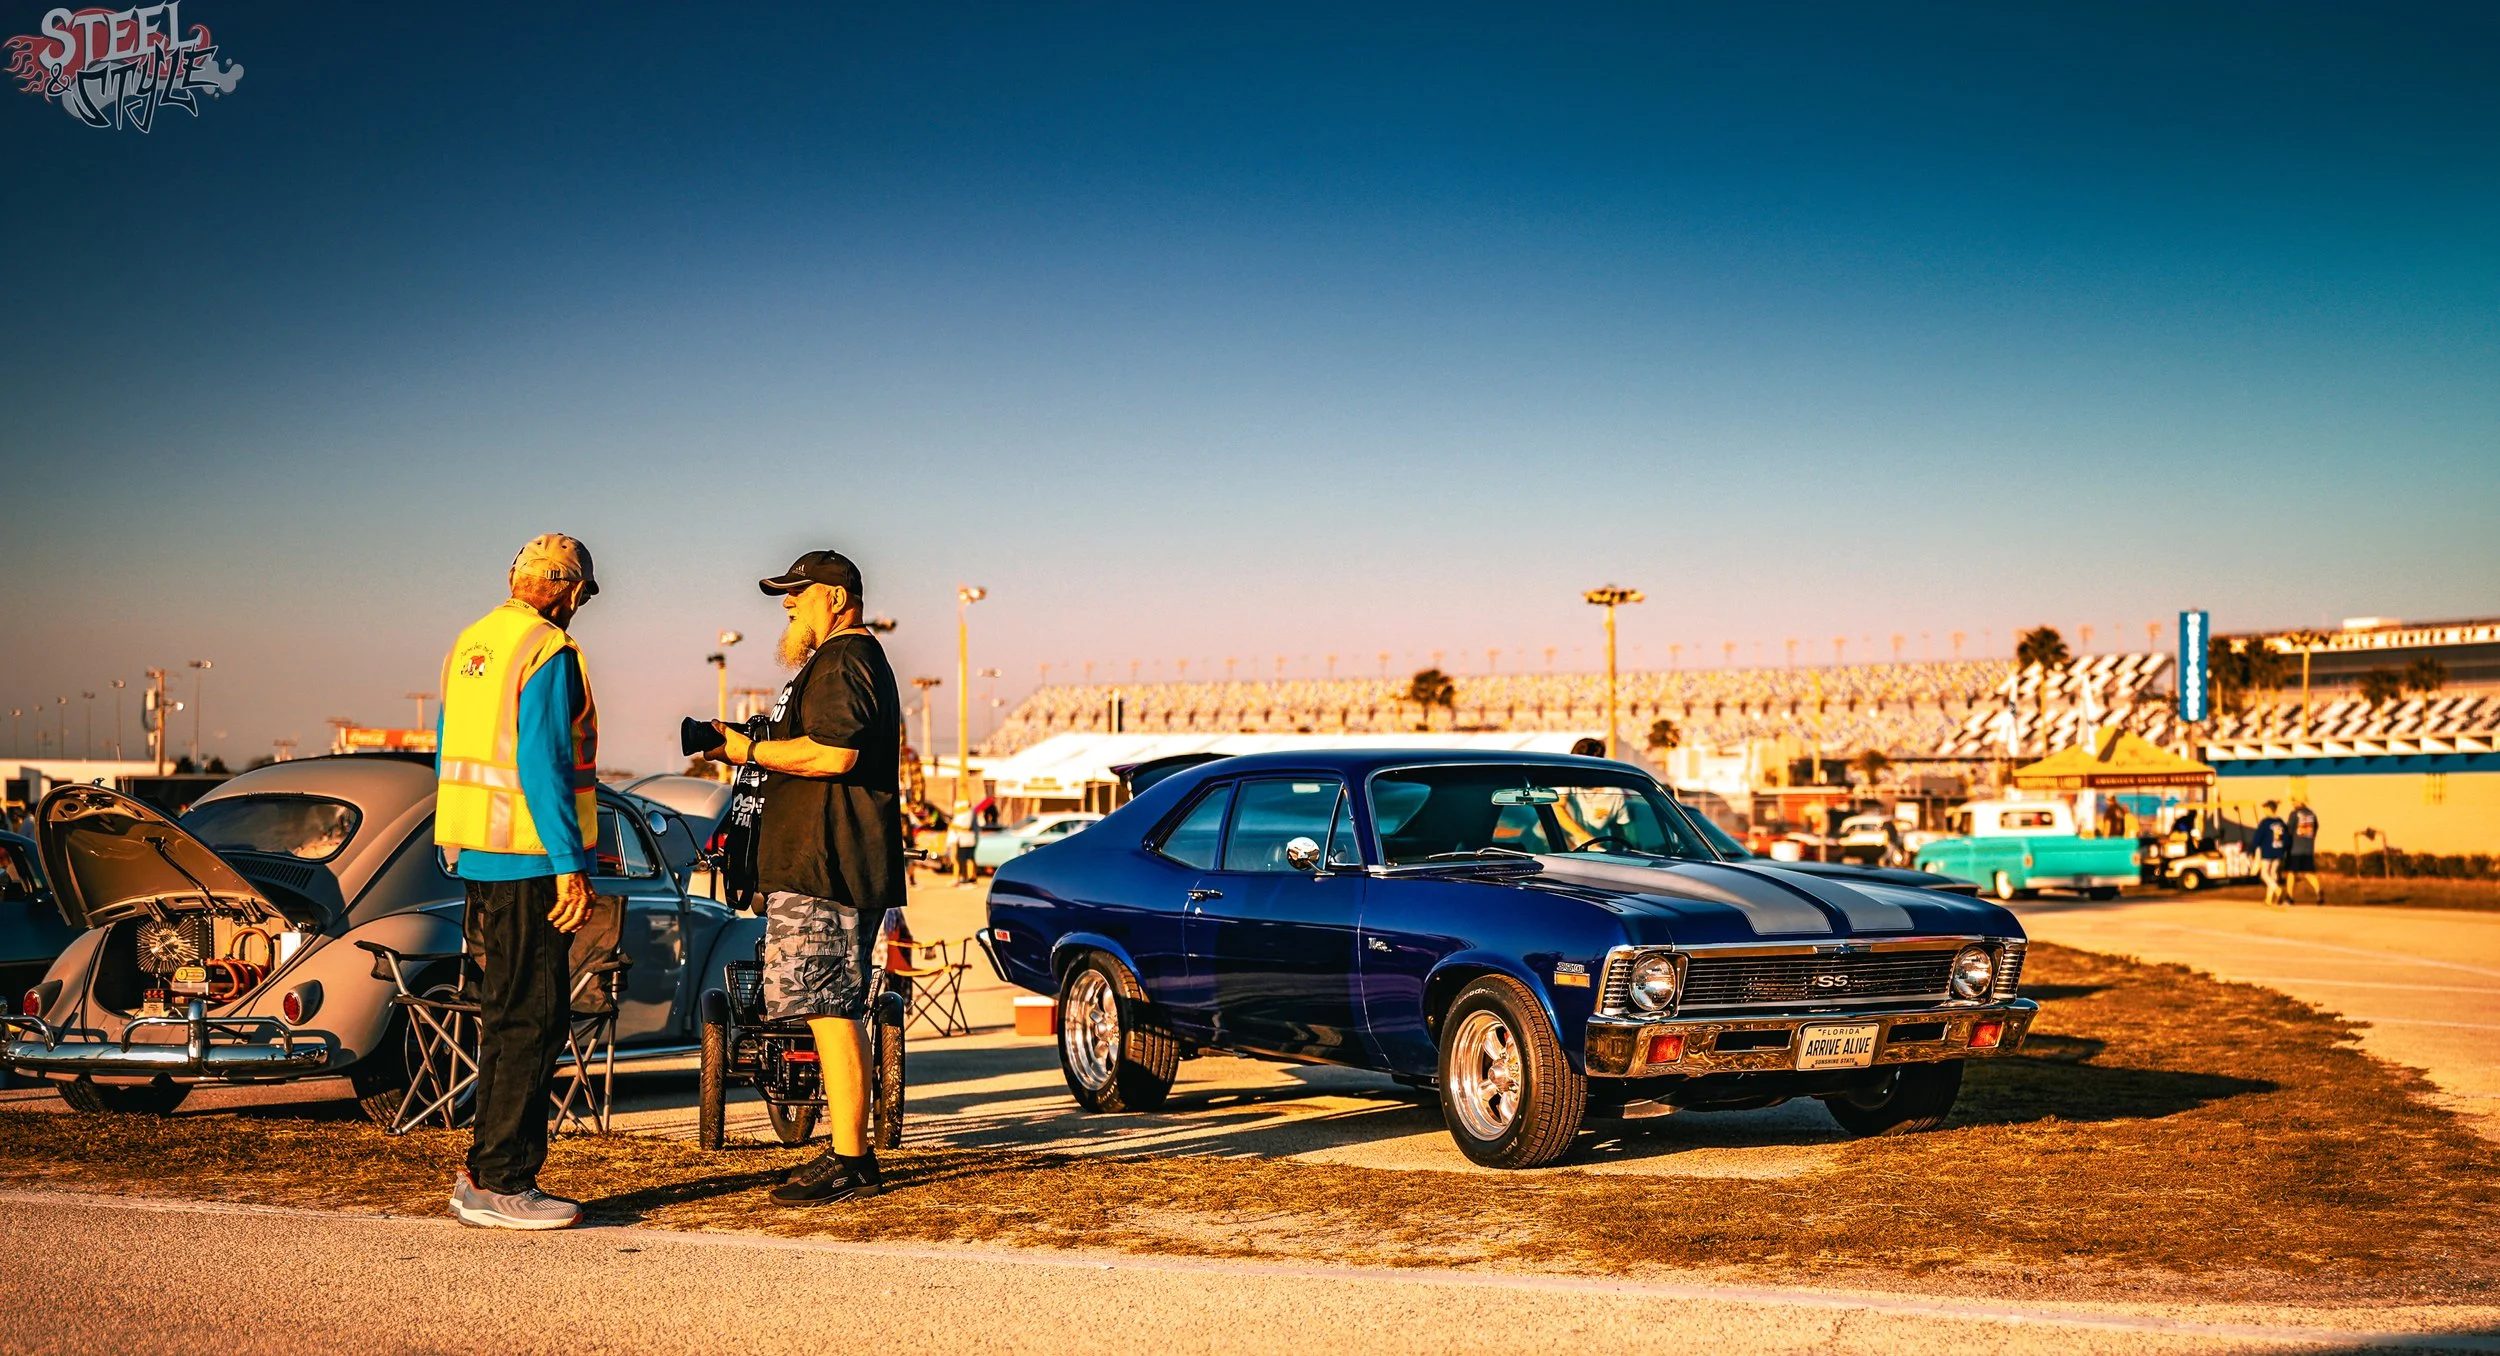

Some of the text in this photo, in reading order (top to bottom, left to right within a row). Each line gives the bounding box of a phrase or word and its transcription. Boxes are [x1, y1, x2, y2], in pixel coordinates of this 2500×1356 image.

[1822, 1028, 1860, 1036] FLORIDA
[1805, 1037, 1871, 1056] ARRIVE ALIVE
